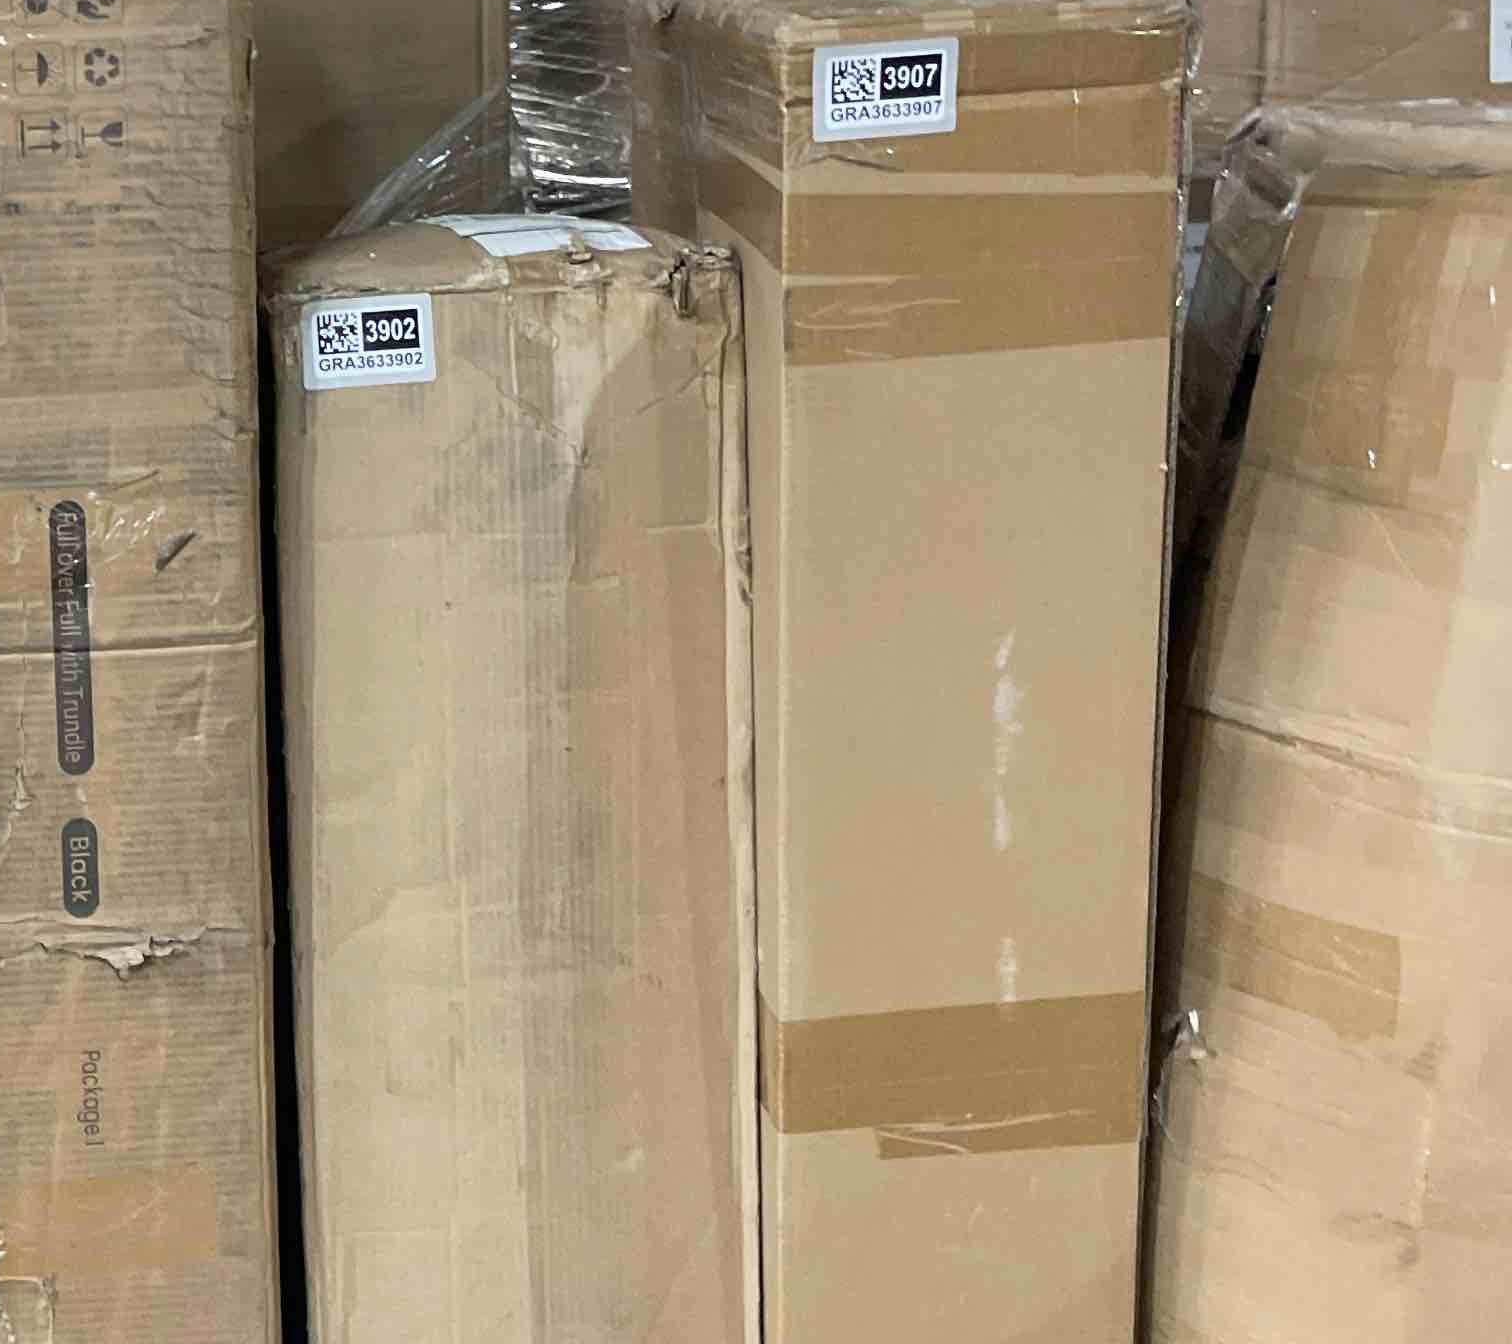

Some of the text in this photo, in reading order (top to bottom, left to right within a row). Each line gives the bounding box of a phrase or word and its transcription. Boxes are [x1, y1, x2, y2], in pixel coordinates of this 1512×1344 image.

[883, 63, 938, 91] 3907
[831, 100, 943, 122] GRA3633907
[365, 317, 416, 342] 3902
[319, 352, 423, 371] GRA3633902
[56, 512, 81, 549] Full
[57, 553, 74, 593] over
[56, 600, 82, 635] Full
[63, 686, 88, 763] Trundle
[70, 836, 92, 903] Black
[76, 1050, 103, 1136] Package
